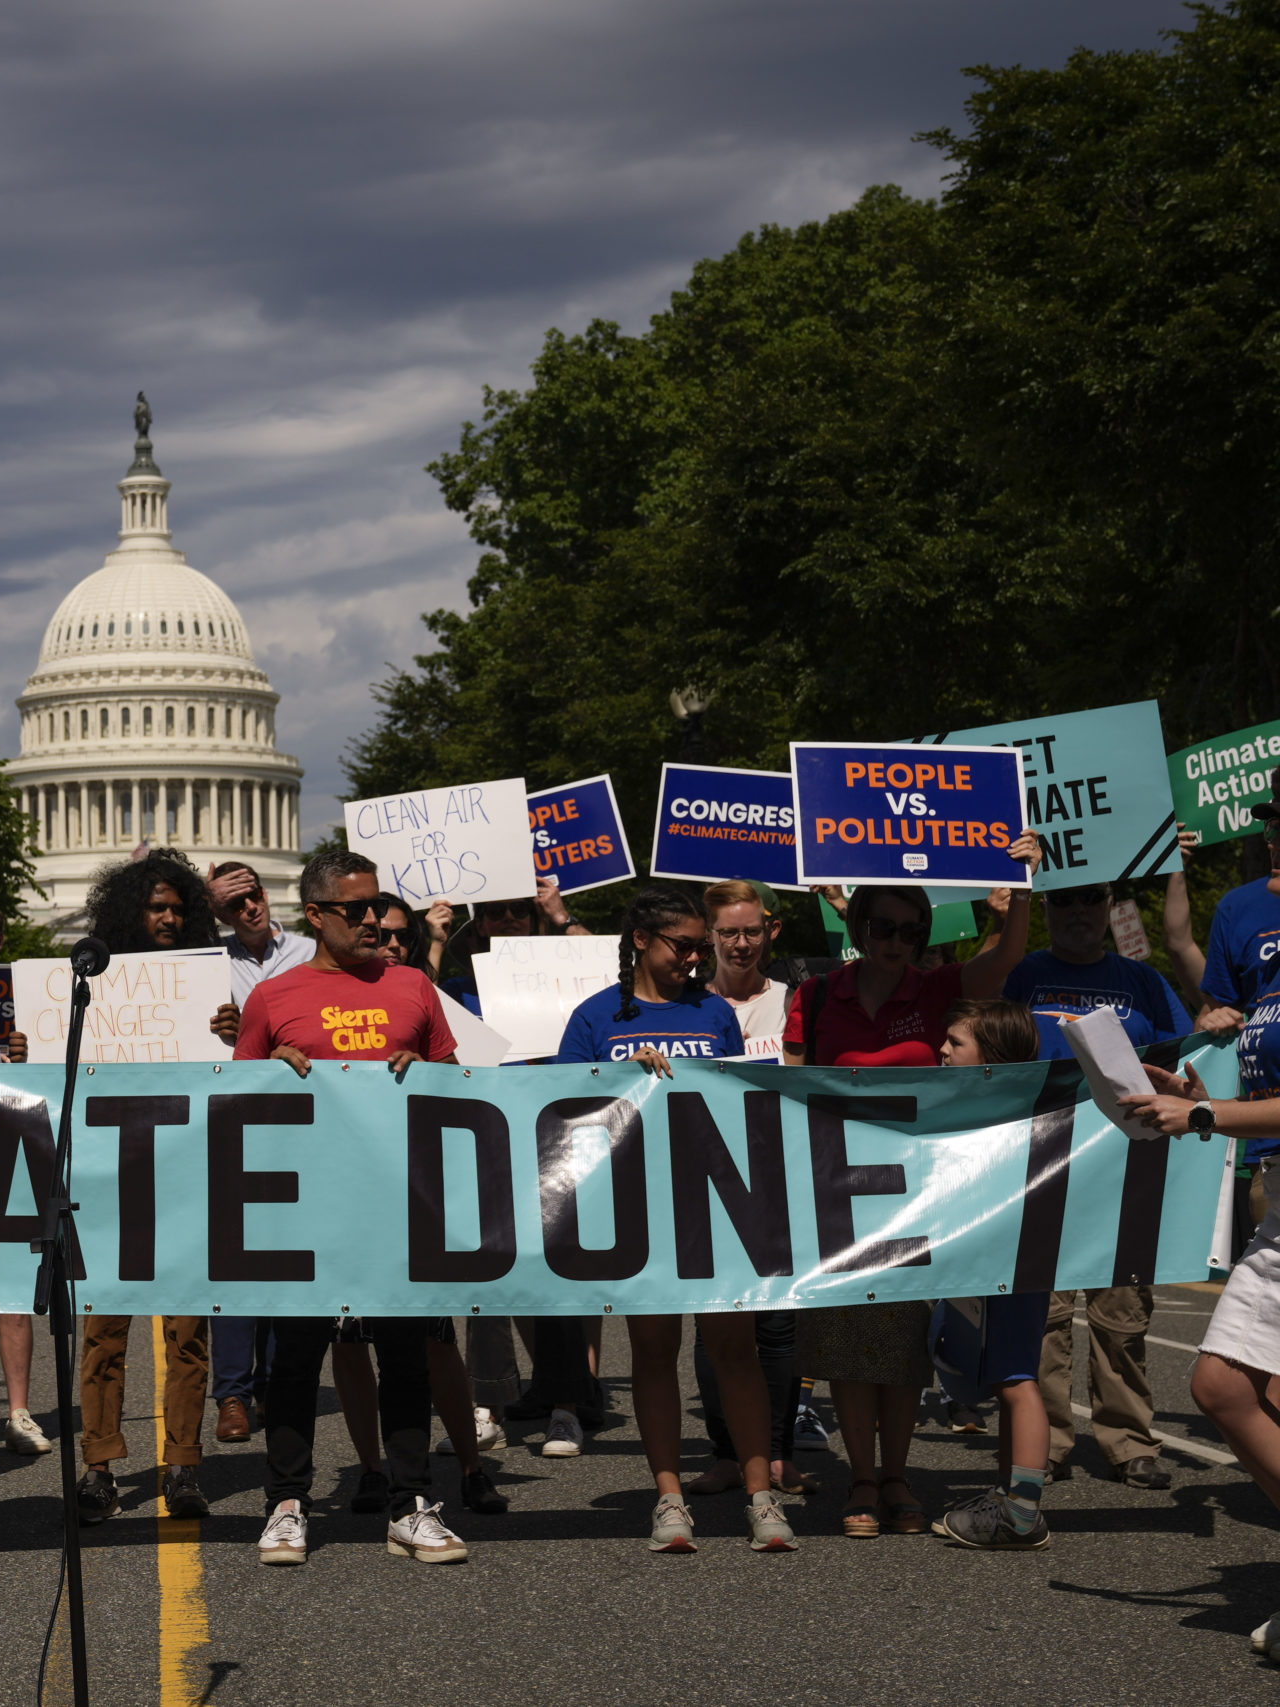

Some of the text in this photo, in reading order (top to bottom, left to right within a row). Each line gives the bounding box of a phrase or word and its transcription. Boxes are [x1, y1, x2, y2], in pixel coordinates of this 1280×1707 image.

[1013, 734, 1056, 778] ET
[1185, 735, 1280, 780] Climate
[845, 762, 972, 791] PEOPLE
[357, 787, 490, 839] CLEAN AIR
[670, 797, 795, 828] CONGRES
[885, 792, 936, 816] VS.
[1026, 776, 1112, 825] MATE
[1218, 801, 1254, 834] No
[411, 831, 448, 859] FOR
[815, 817, 1010, 848] POLLUTERS
[1038, 828, 1088, 872] NE
[533, 834, 614, 872] UTERS
[391, 851, 487, 901] KIDS
[34, 1003, 175, 1042] CHANGES
[320, 1006, 389, 1029] Sierra
[331, 1026, 387, 1052] Club
[407, 1090, 931, 1282] DONE
